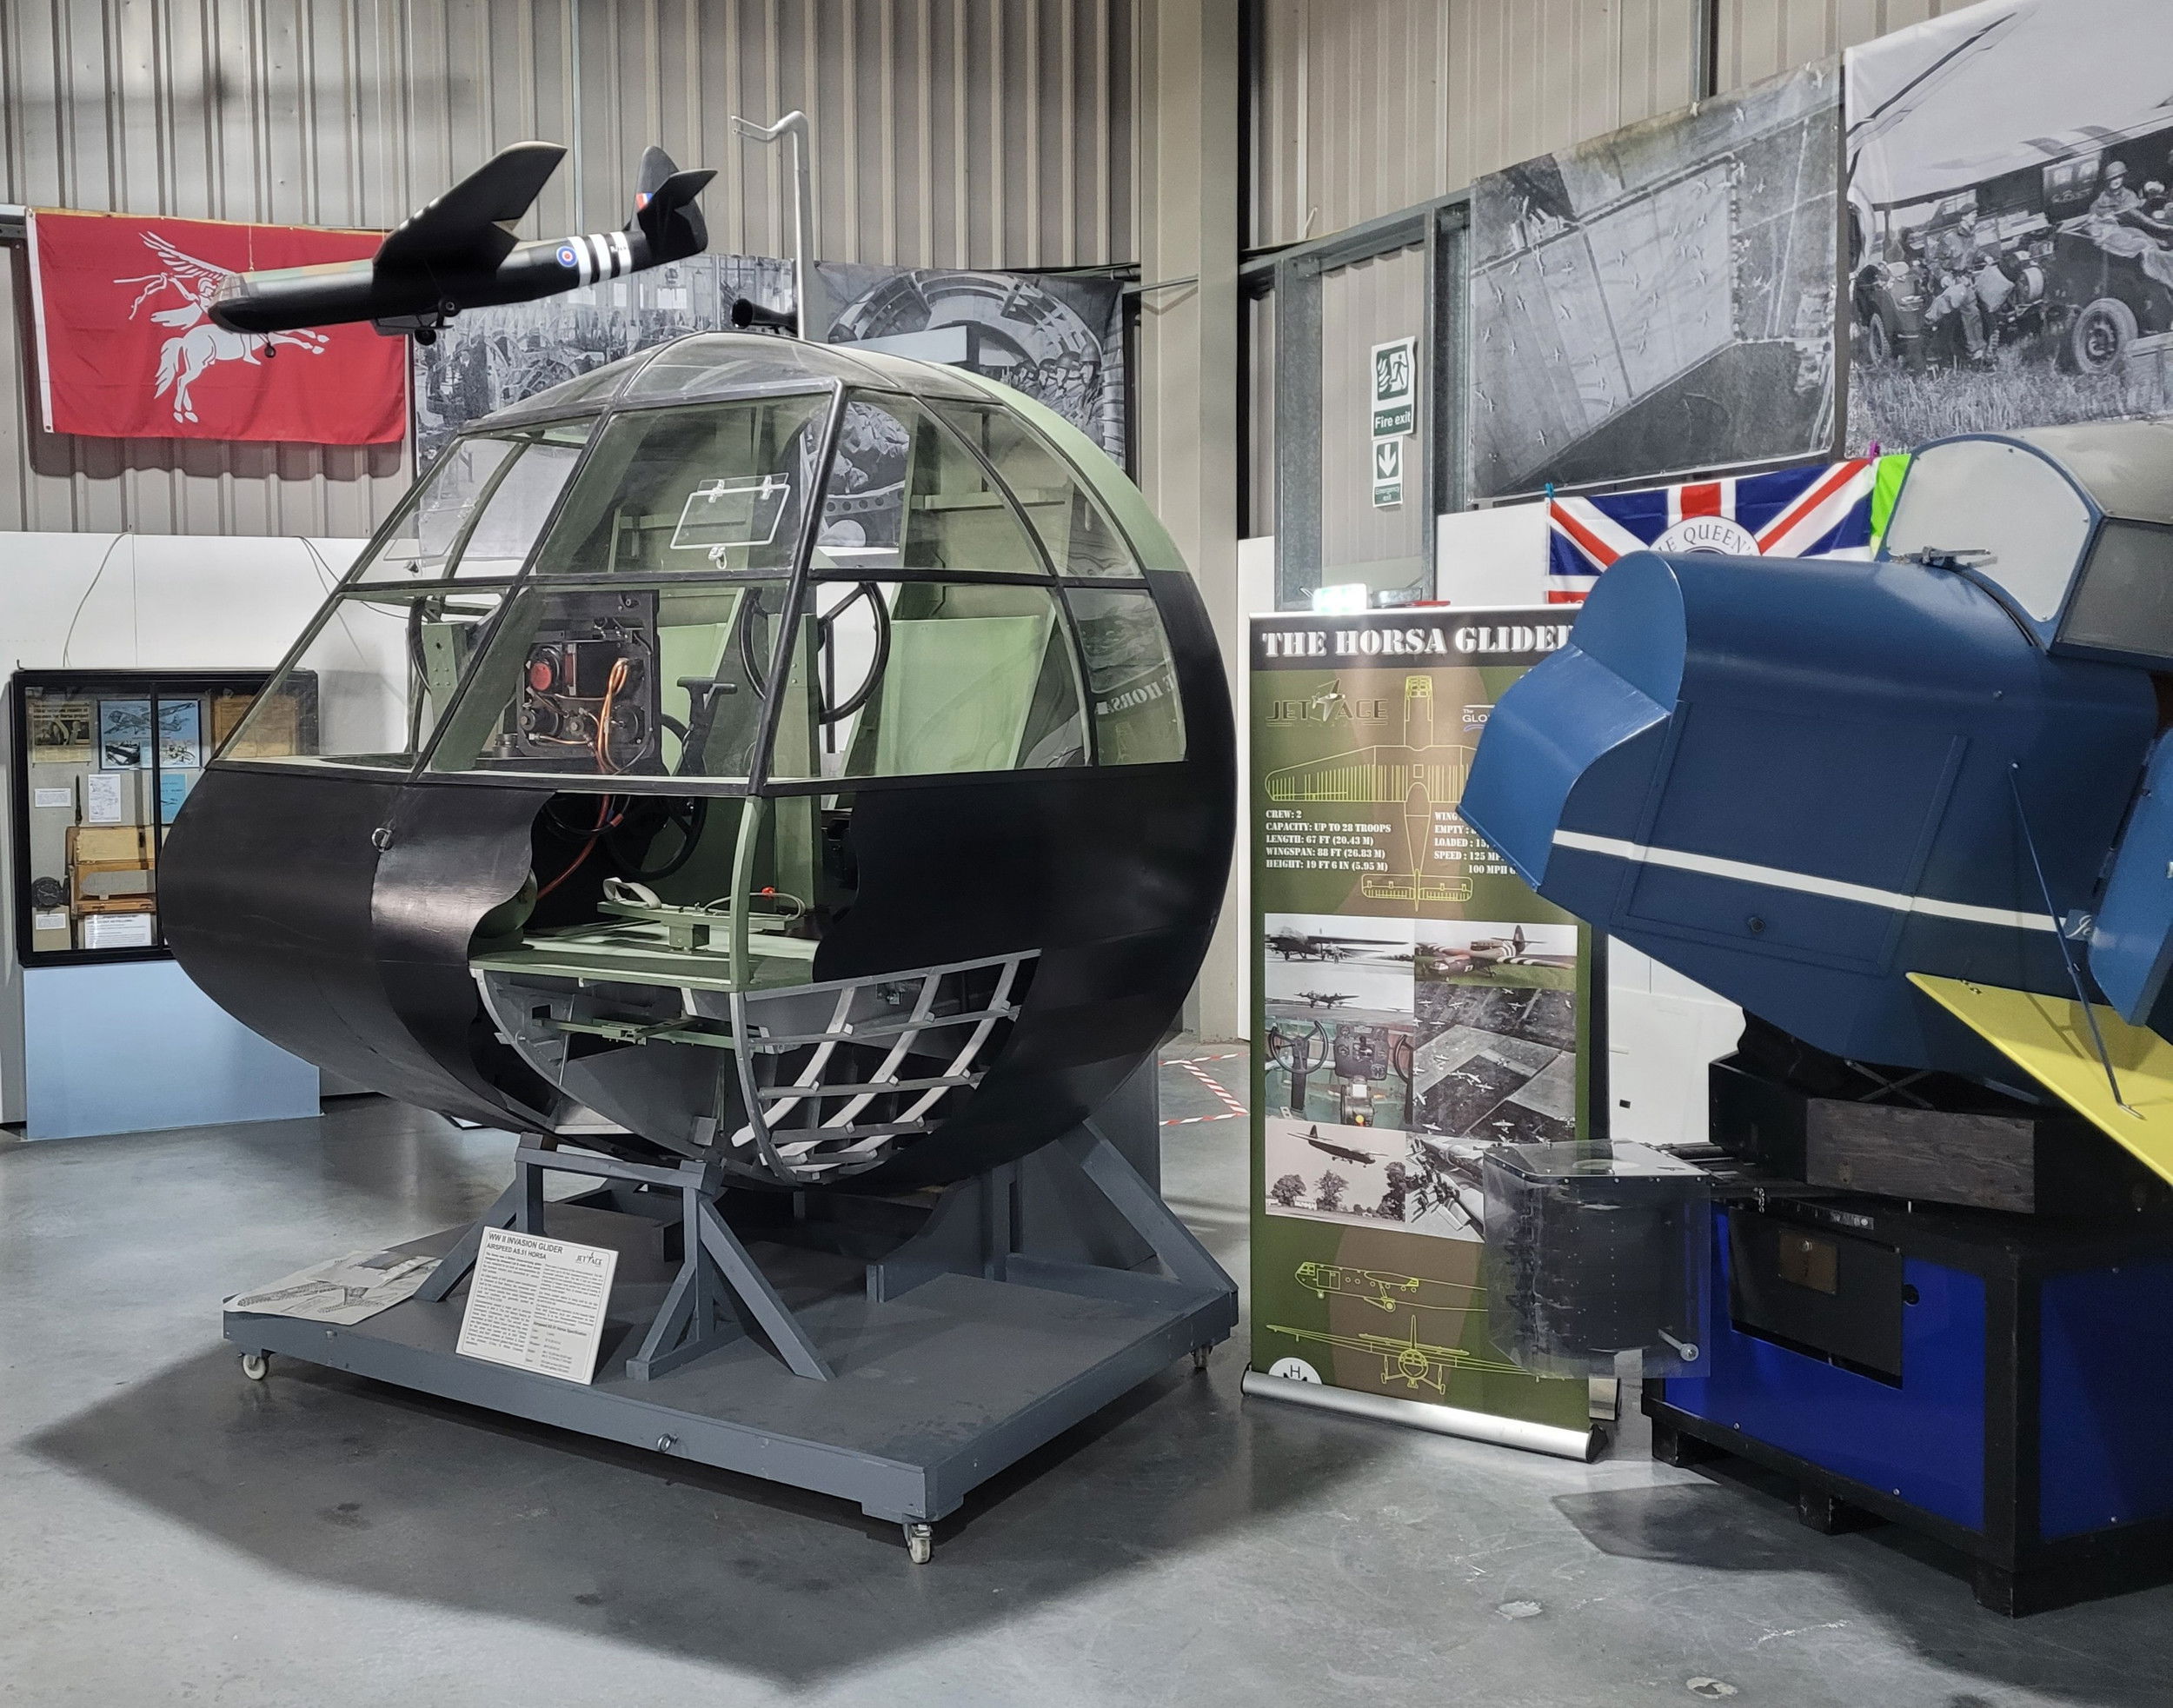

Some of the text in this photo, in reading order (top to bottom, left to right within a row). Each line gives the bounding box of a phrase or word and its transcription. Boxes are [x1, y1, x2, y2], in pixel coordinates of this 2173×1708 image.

[1375, 410, 1411, 429] Fire exit
[1262, 630, 1326, 657] THE
[1335, 627, 1447, 656] HORSA
[1266, 699, 1387, 721] JET AGE
[1462, 714, 1488, 722] GLO
[1266, 810, 1302, 819] CREW: 2
[1266, 822, 1392, 834] CAPACITY: UP TO 28 TROOPS
[1434, 825, 1464, 834] EMPTY
[1266, 834, 1374, 847] LENGTH: 67 FT (20.43 M)
[1434, 838, 1468, 847] LOADED
[1266, 847, 1386, 860] WINGSPAN: 88 FT (26.83 M)
[1434, 851, 1462, 860] SPEED
[1470, 852, 1485, 861] 125
[1266, 860, 1388, 872] HEIGHT: 19 FT 6 IN (5.95 M)
[1468, 865, 1485, 874] 100
[1486, 865, 1507, 874] MPH
[488, 1233, 502, 1241] WW
[507, 1236, 537, 1249] INVASION
[538, 1243, 563, 1254] GLIDER
[487, 1242, 513, 1253] AIRSPEED
[528, 1250, 547, 1259] HORSA
[1290, 1365, 1301, 1379] H
